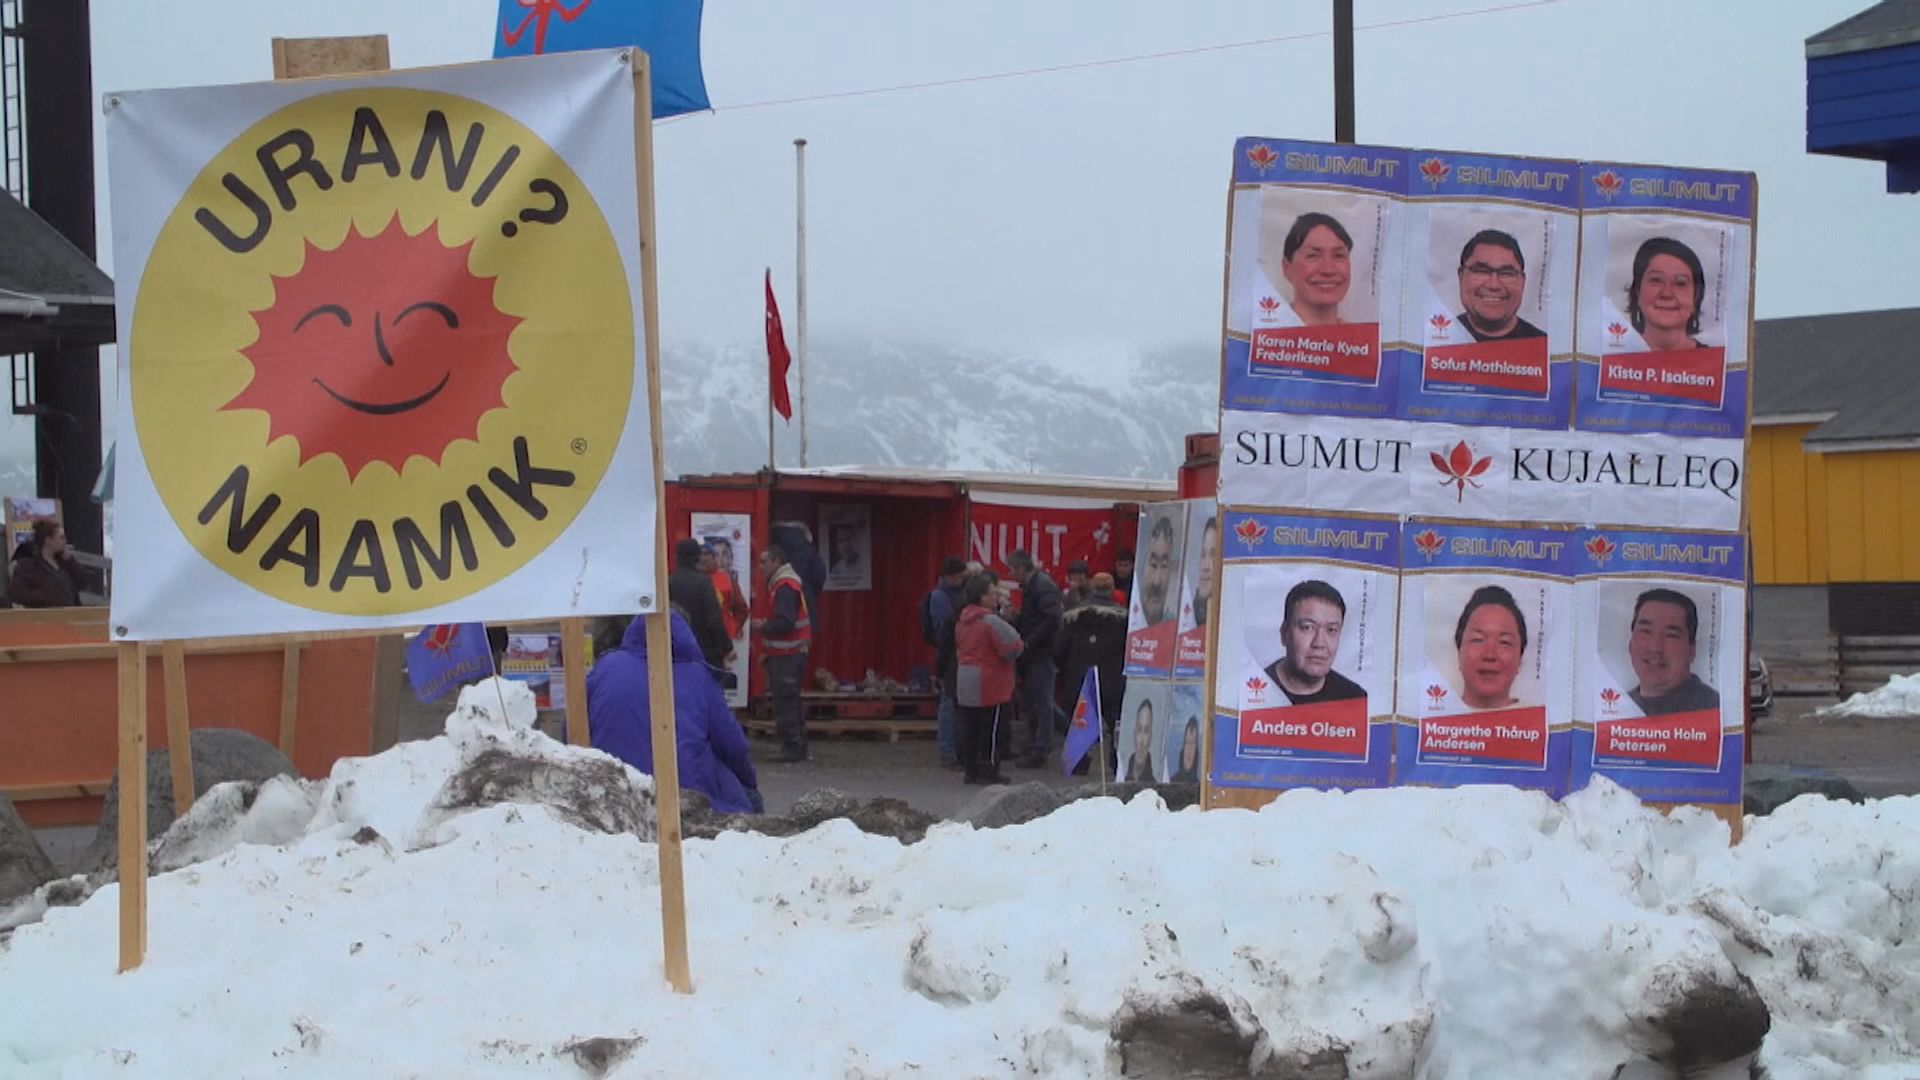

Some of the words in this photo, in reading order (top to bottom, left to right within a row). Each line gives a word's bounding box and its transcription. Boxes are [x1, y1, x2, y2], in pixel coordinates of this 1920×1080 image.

[1284, 152, 1400, 178] SIUMUT
[195, 107, 569, 253] URANI?
[1456, 166, 1570, 192] SIUMUT
[1629, 177, 1741, 202] SIUMUT
[1255, 348, 1330, 366] Frederiksen
[1256, 334, 1295, 348] Karen
[1297, 337, 1335, 352] Marie
[1337, 341, 1369, 357] Kyed
[1430, 356, 1467, 372] Sofus
[1469, 359, 1543, 377] Mathiassen
[1608, 364, 1643, 380] Kista
[1646, 367, 1658, 382] P.
[1661, 369, 1715, 387] Isaksen
[1235, 430, 1412, 474] SIUMUT
[1512, 447, 1741, 501] KUJALLEQ
[197, 436, 576, 593] NAAMIK
[1273, 526, 1389, 551] SIUMUT
[1451, 537, 1565, 561] SIUMUT
[1622, 542, 1734, 564] SIUMUT
[1251, 719, 1308, 736] Anders
[1311, 721, 1357, 738] Olsen
[1425, 722, 1492, 739] Margrethe
[1494, 725, 1541, 742] Thårup
[1610, 725, 1671, 739] Masauna
[1674, 728, 1707, 741] Holm
[1424, 736, 1486, 751] Andersen
[1609, 738, 1667, 753] Petersen
